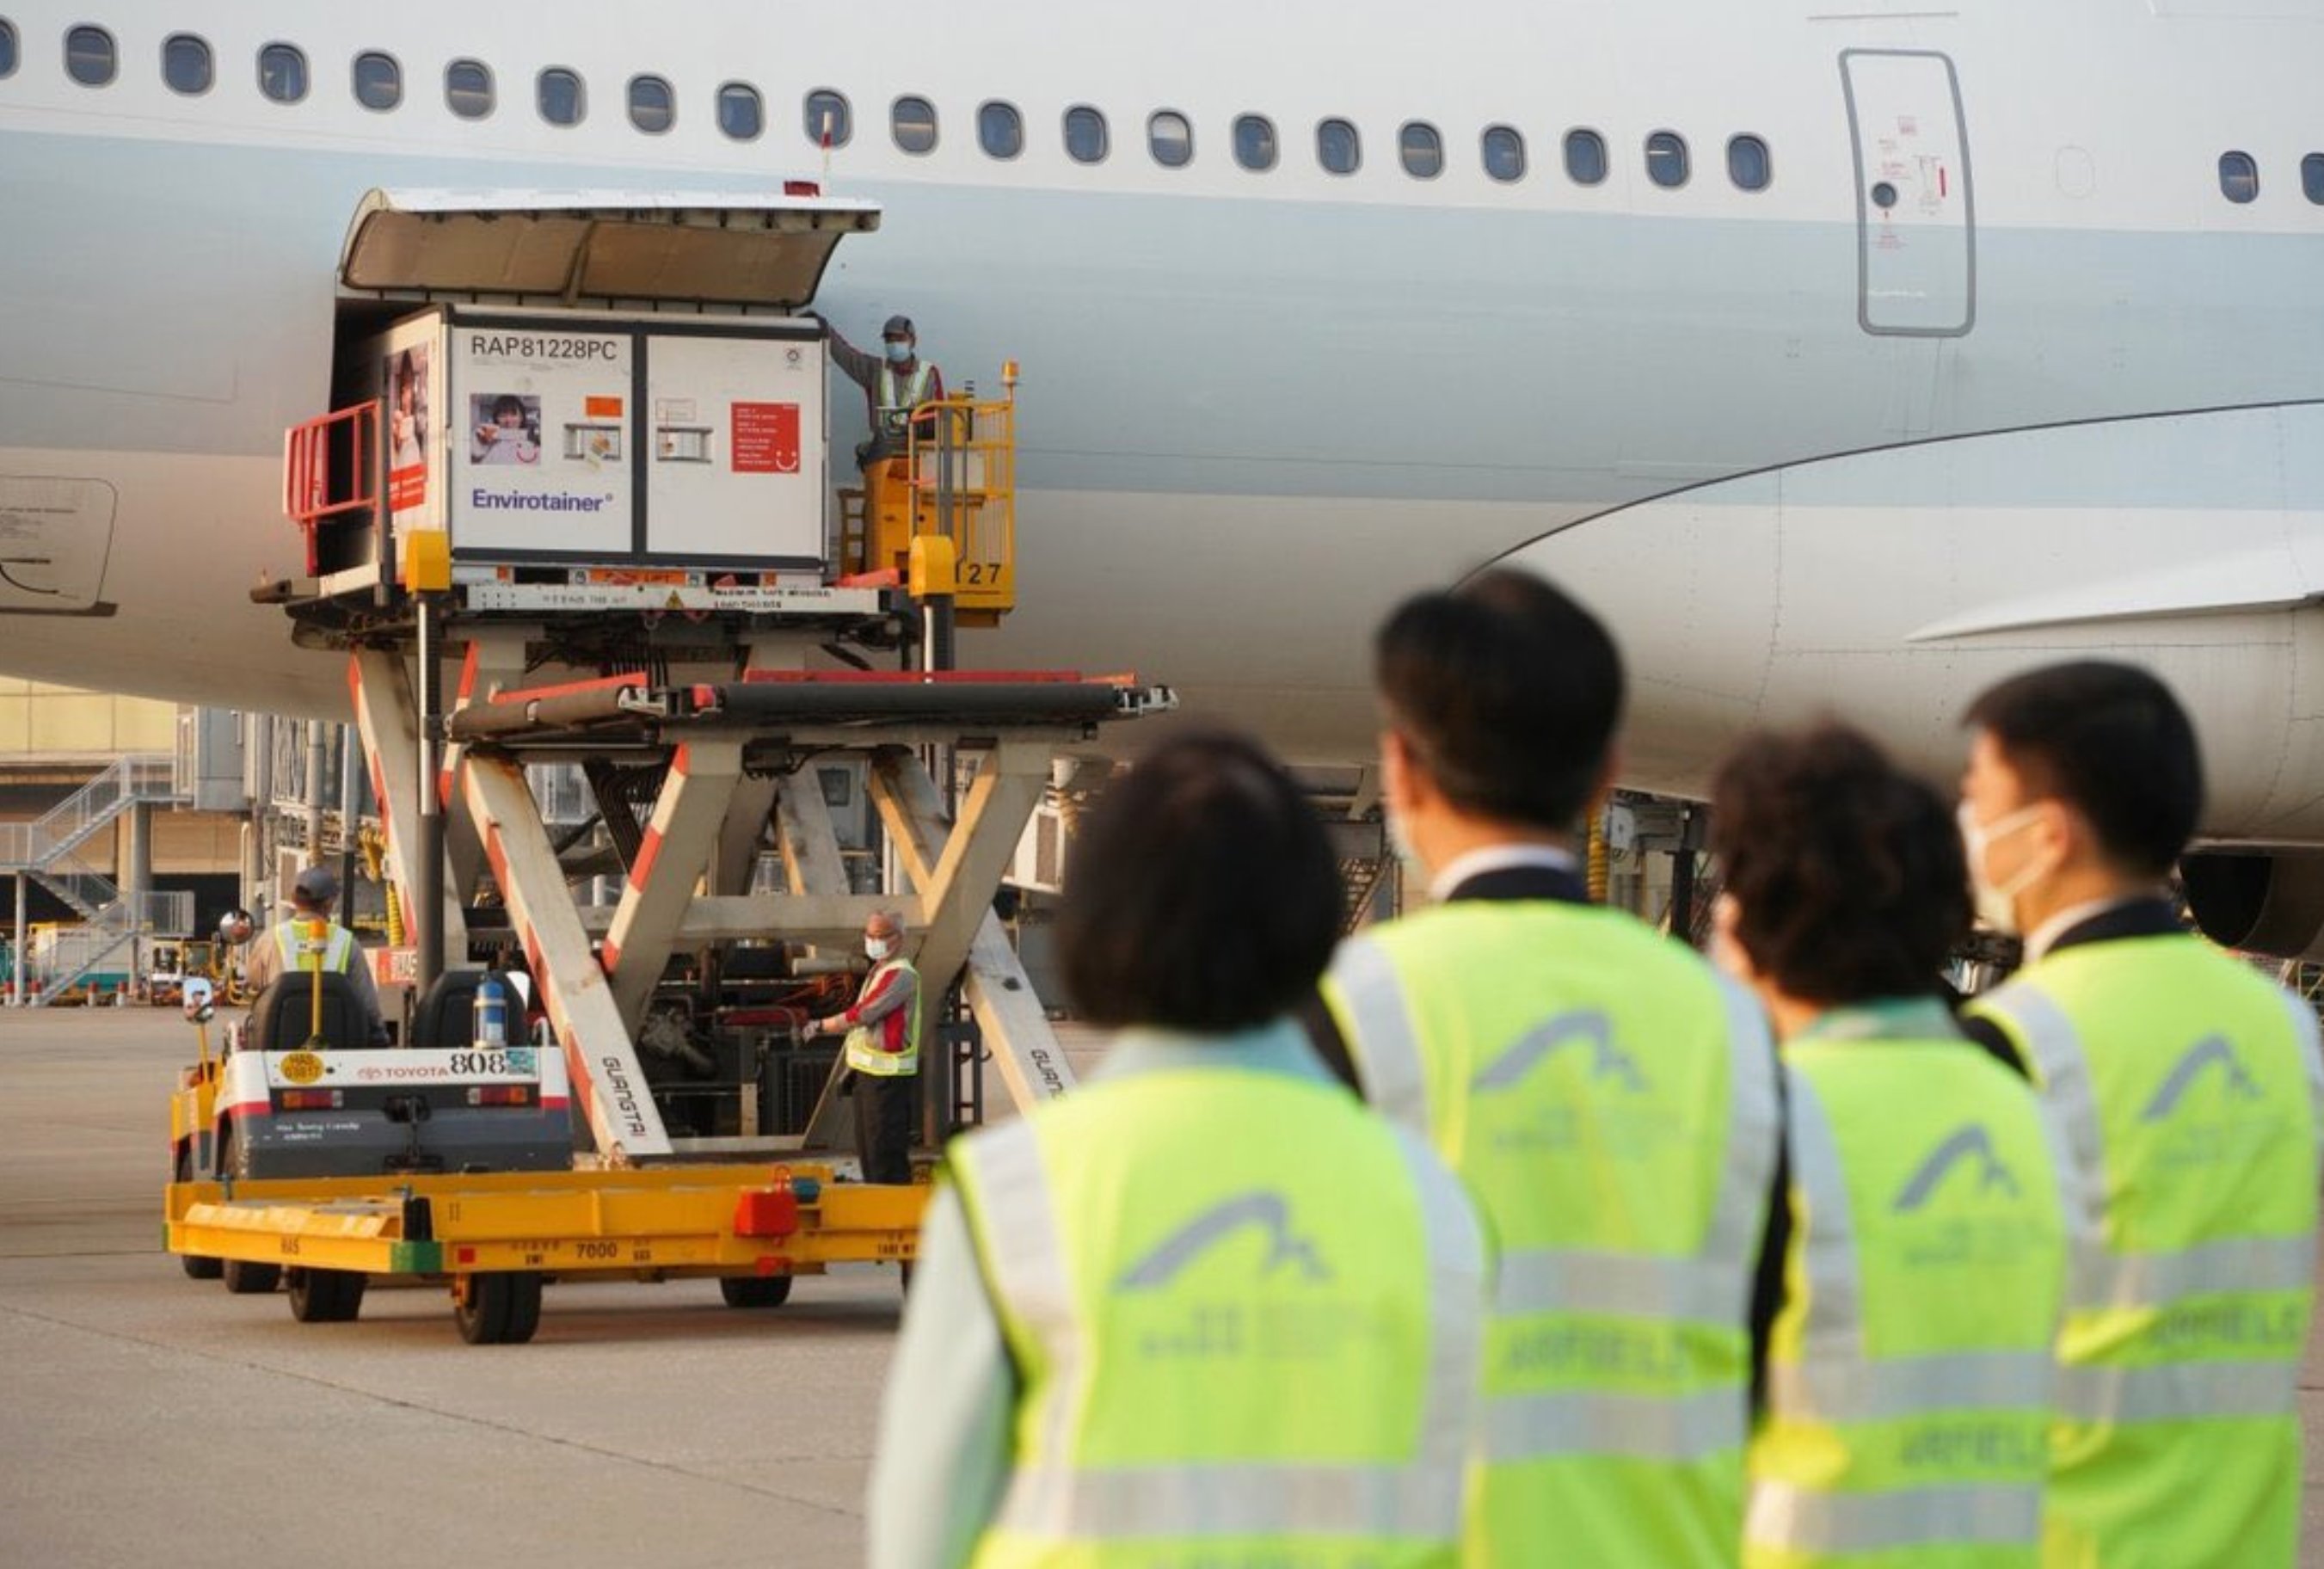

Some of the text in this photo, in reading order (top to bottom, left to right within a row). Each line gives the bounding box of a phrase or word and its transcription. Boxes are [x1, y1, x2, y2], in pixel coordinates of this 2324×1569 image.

[470, 335, 618, 360] RAP81228PC
[385, 1066, 450, 1079] TOYOTA
[450, 1051, 506, 1074] 808
[602, 1056, 648, 1136] GUANGTAI
[576, 1241, 618, 1259] 7000
